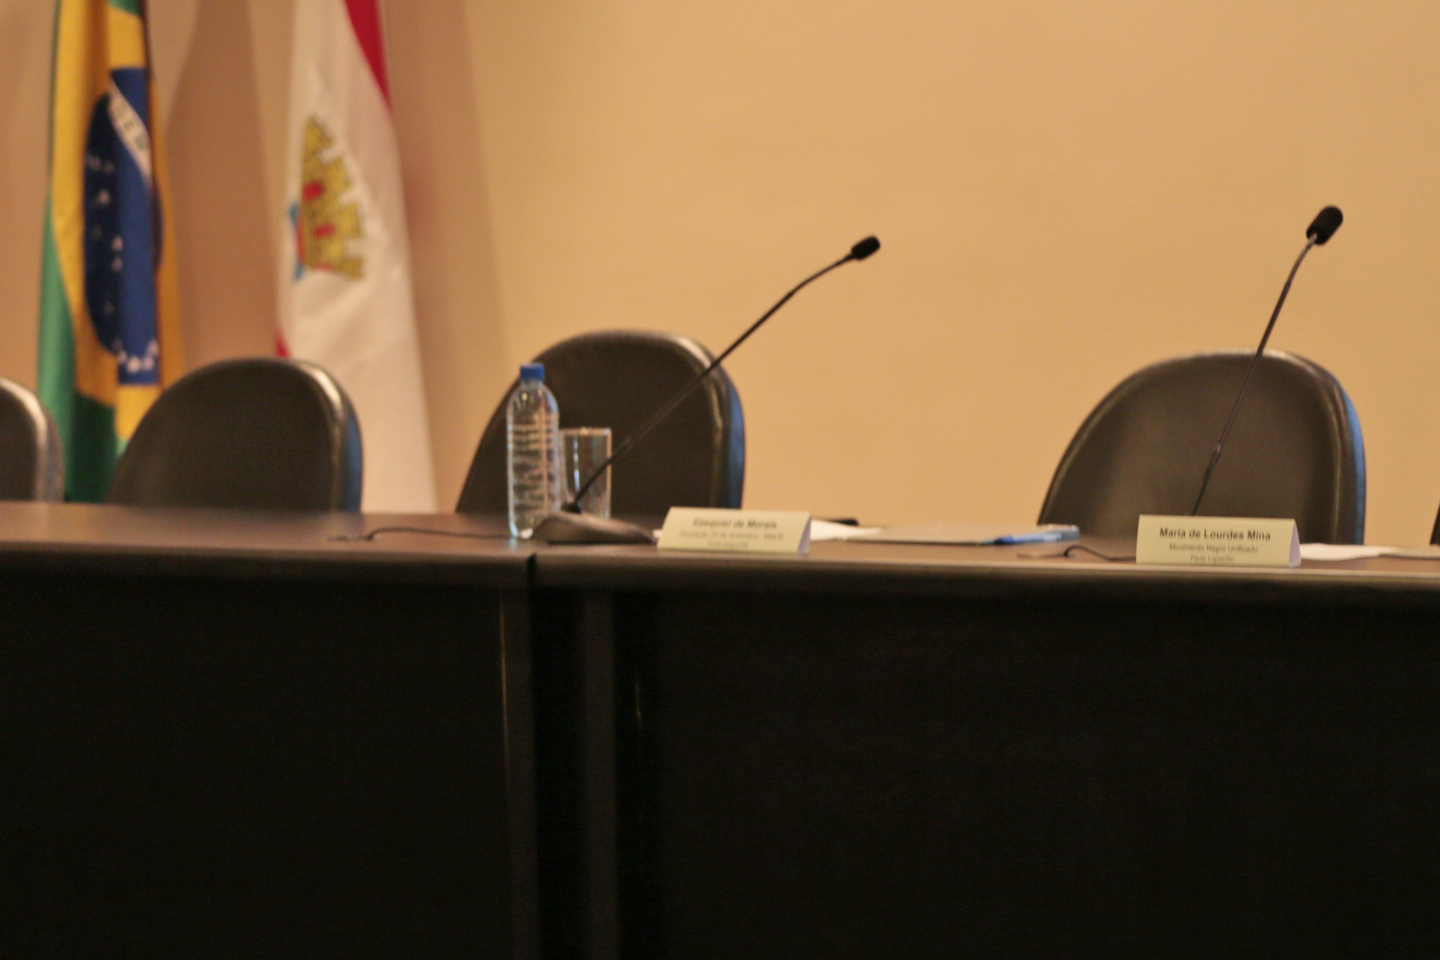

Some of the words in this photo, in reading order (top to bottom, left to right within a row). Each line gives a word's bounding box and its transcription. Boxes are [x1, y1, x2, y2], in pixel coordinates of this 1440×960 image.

[733, 518, 744, 528] de
[1159, 526, 1186, 538] Maria
[1188, 527, 1201, 538] de
[1203, 528, 1244, 540] Lourdes
[1247, 529, 1271, 541] Mina
